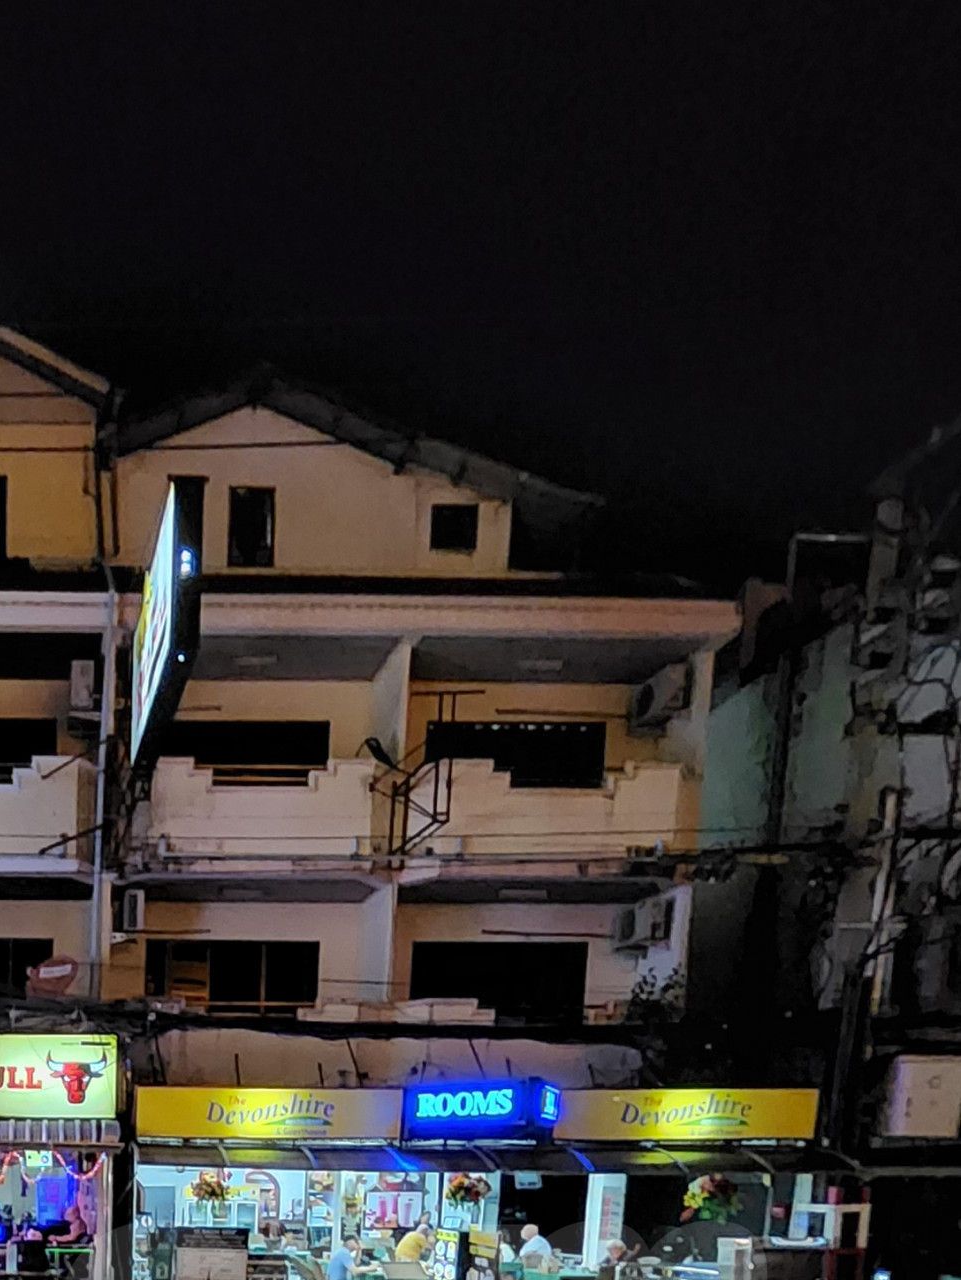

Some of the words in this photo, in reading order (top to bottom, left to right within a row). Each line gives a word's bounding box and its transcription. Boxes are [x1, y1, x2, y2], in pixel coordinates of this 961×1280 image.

[206, 1093, 336, 1126] Devonshire
[228, 1095, 246, 1106] The
[415, 1088, 515, 1119] ROOMS
[620, 1093, 753, 1127] Devonshire
